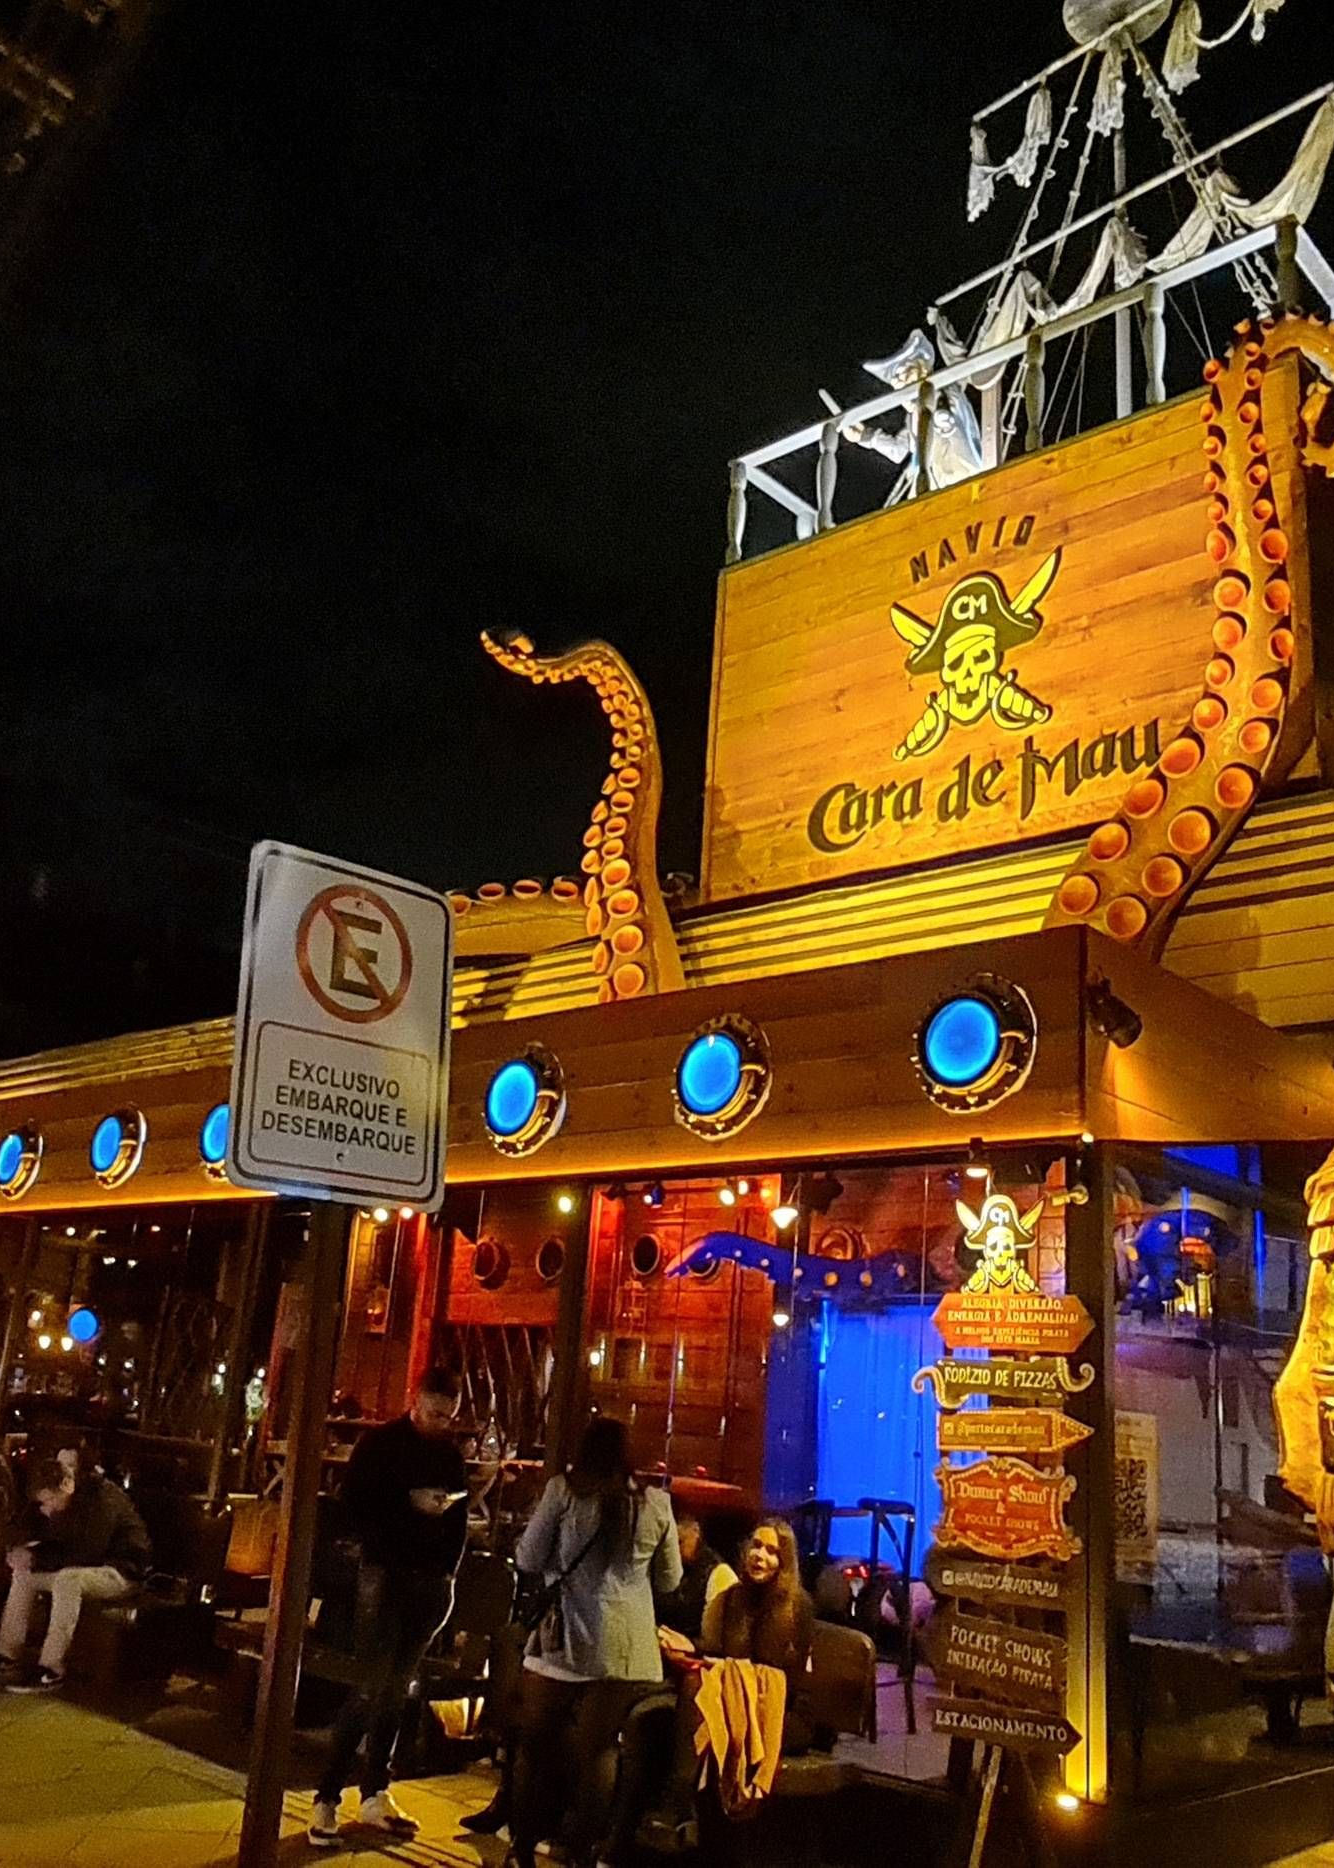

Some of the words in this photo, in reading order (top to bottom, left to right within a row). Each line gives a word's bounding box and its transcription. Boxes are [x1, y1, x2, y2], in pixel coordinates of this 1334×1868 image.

[909, 515, 1036, 584] NAVIO
[952, 594, 987, 621] CM
[807, 777, 924, 853] Cara
[936, 754, 1006, 823] de
[1018, 717, 1164, 820] Mau
[330, 909, 383, 1001] E
[289, 1058, 400, 1101] EXCLUSIVO
[275, 1085, 390, 1126] EMBARQUE
[396, 1107, 407, 1128] E
[261, 1110, 416, 1156] DESEMBARQUE
[944, 1366, 991, 1385] RODÍZIO
[994, 1370, 1008, 1386] DE
[1013, 1370, 1057, 1389] PIZZAS
[956, 1481, 1004, 1500] Dinner
[950, 1625, 1001, 1654] POCKET
[1004, 1639, 1054, 1669] SHOWS
[946, 1650, 1008, 1679] INTERAÇÃO
[1011, 1665, 1054, 1691] PIRATA
[935, 1709, 1069, 1742] ESTACIONAMENTO
